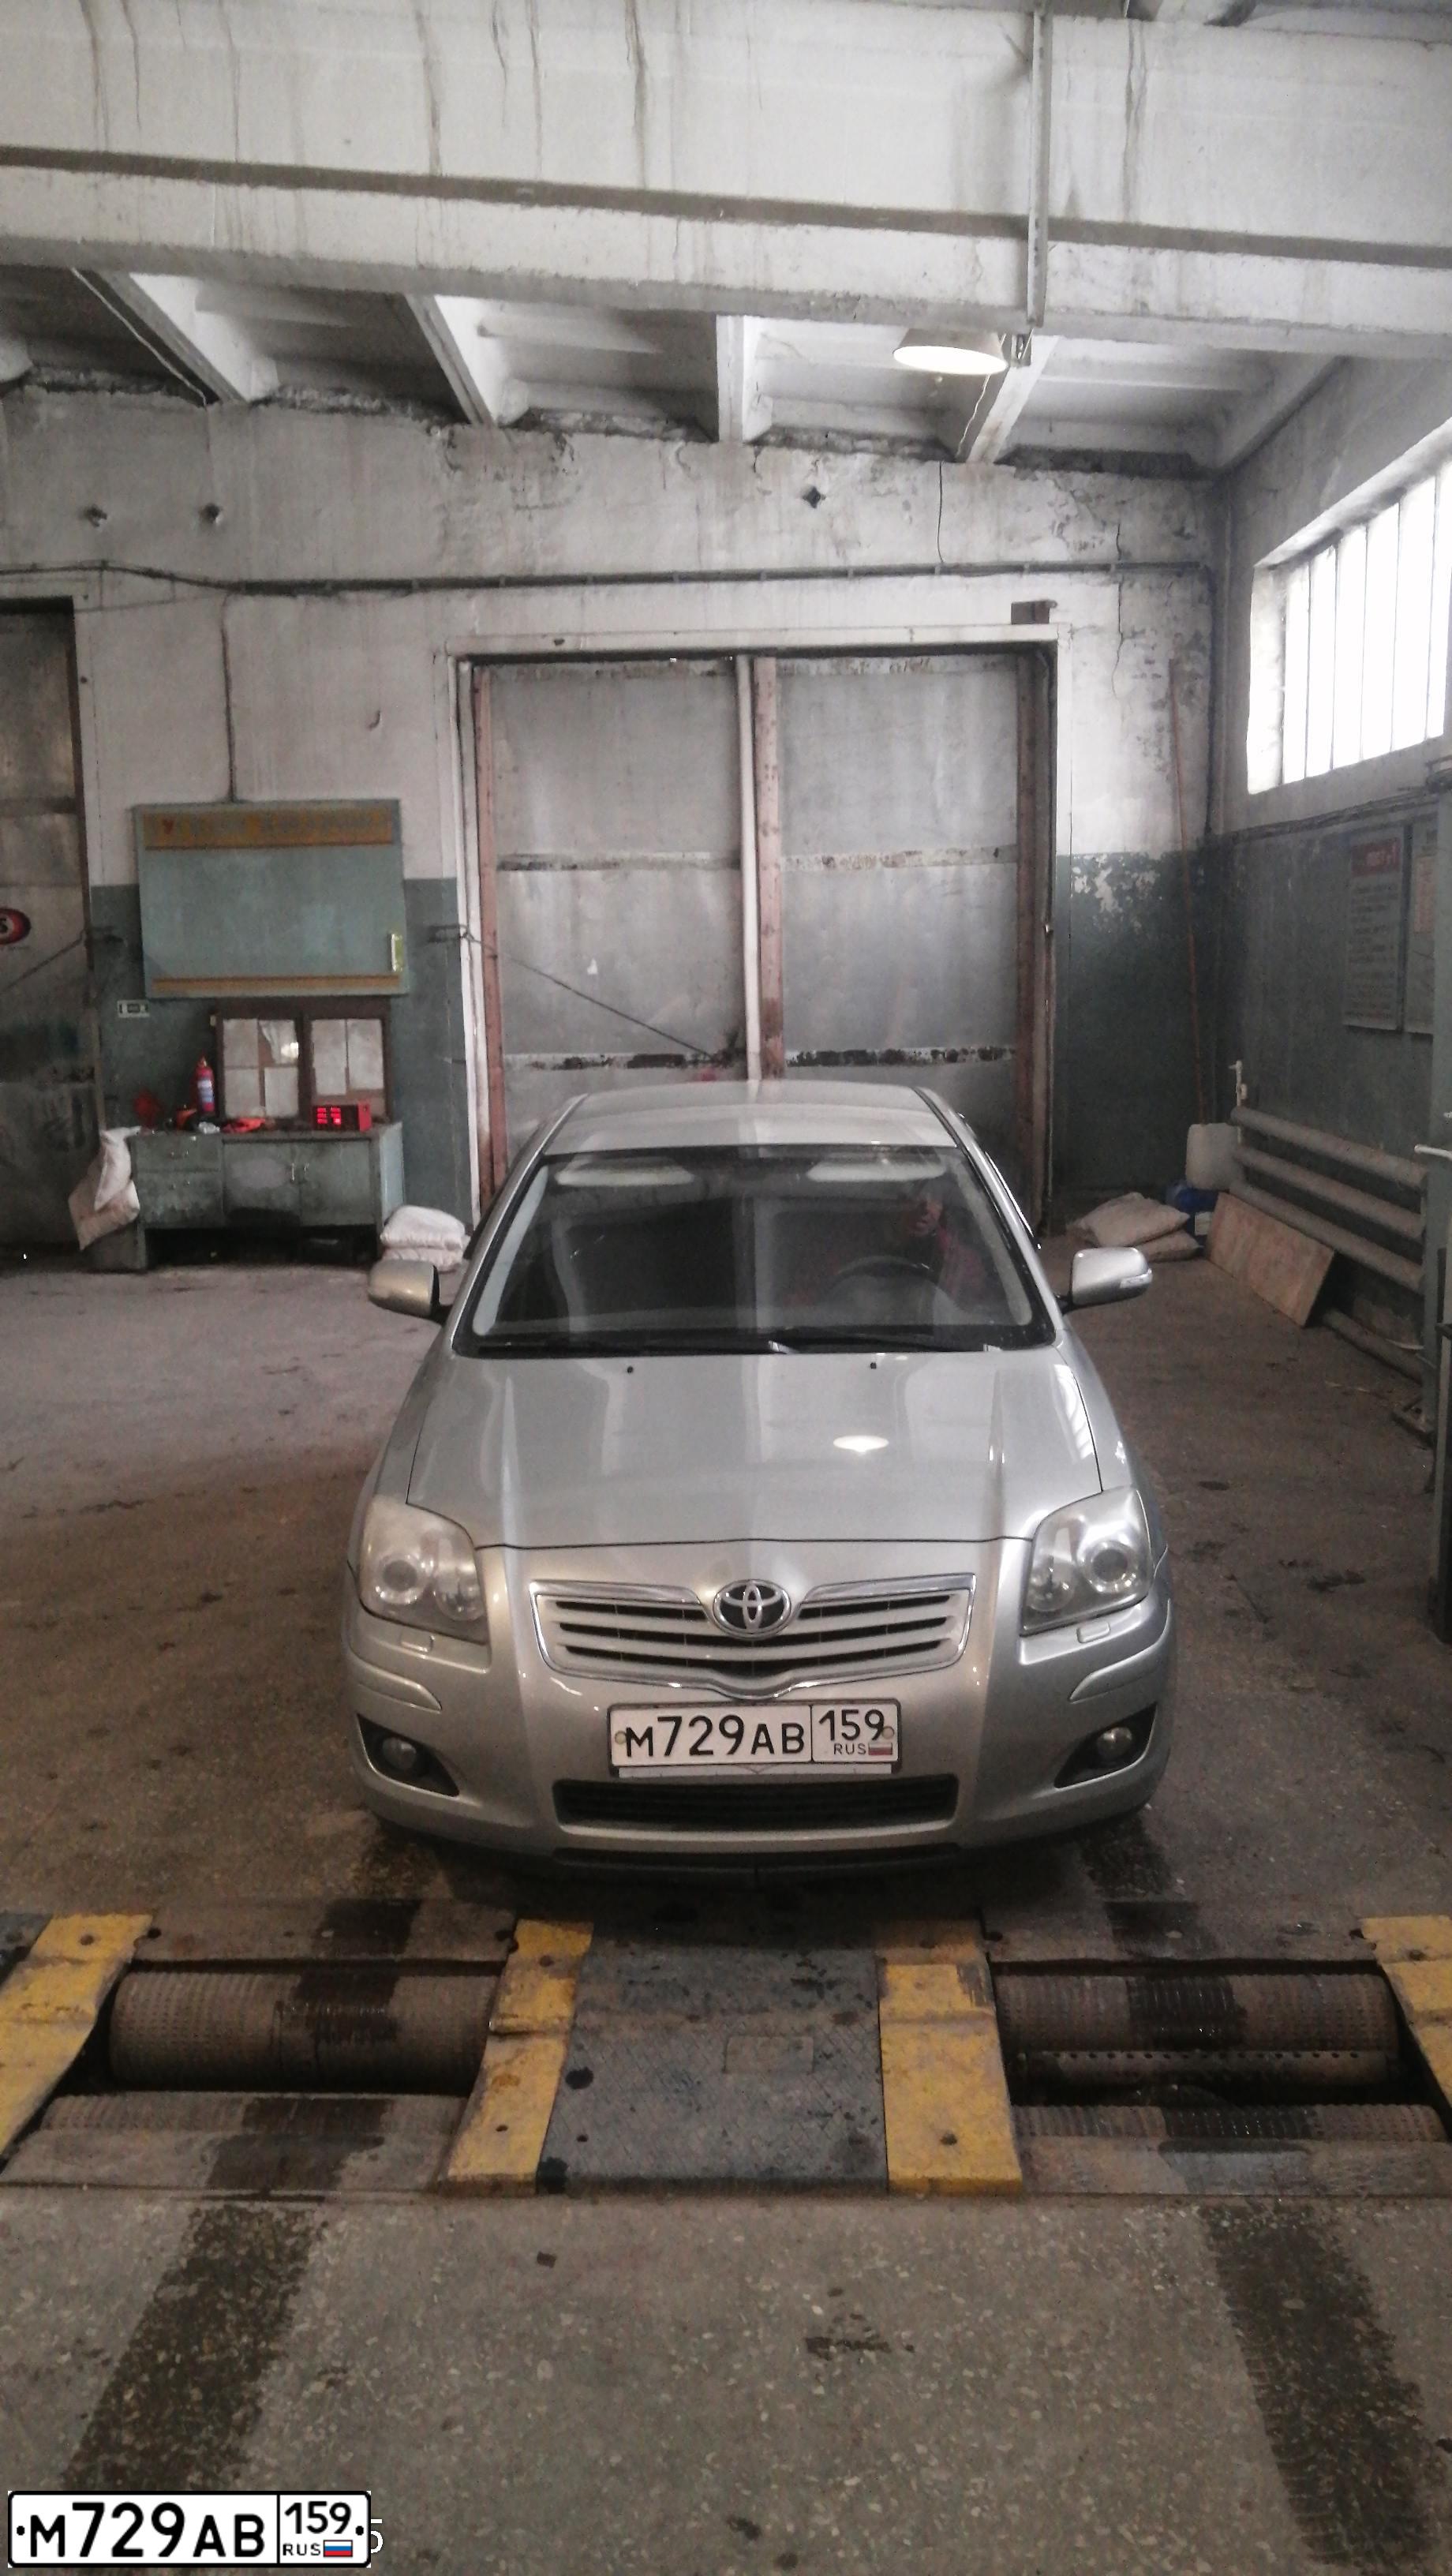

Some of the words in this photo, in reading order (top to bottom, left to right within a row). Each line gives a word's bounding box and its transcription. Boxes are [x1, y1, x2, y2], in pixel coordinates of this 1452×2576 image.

[626, 1715, 804, 1758] М729АВ
[818, 1709, 885, 1741] 159
[834, 1743, 866, 1755] RUS
